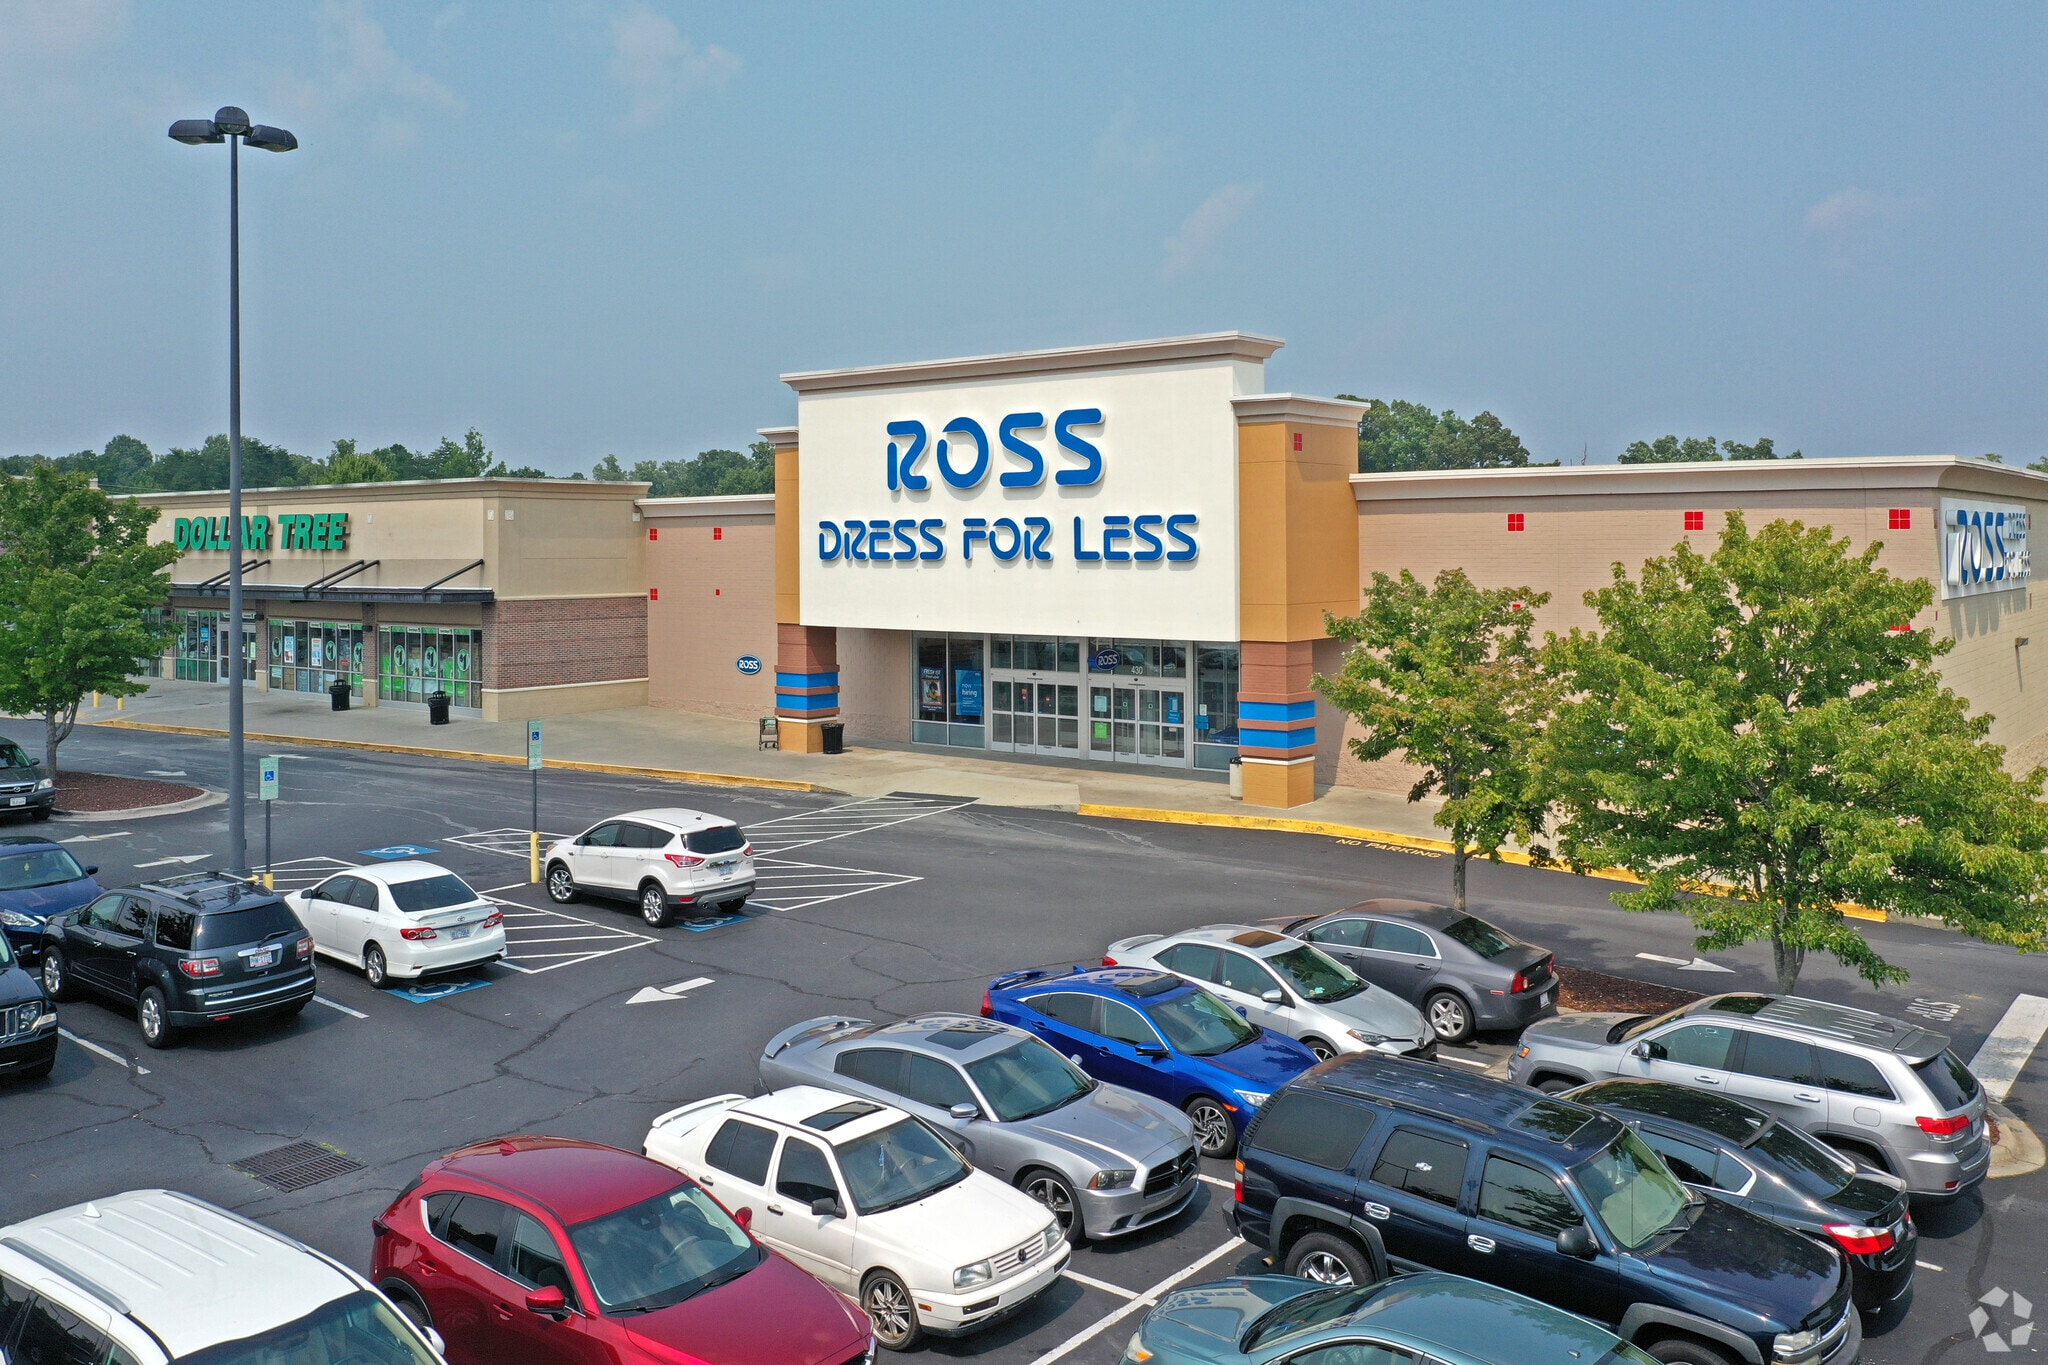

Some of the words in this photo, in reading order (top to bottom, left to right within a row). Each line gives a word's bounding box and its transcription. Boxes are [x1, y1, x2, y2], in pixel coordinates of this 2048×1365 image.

[887, 408, 1103, 491] ROSS
[278, 513, 348, 550] TREE
[819, 519, 944, 561] DRESS
[964, 517, 1052, 561] FOR
[1074, 514, 1199, 561] LESS
[1946, 510, 2004, 585] ROSS
[738, 659, 759, 670] ROSS
[1098, 654, 1118, 666] ROSS
[1131, 666, 1144, 675] 430
[961, 689, 978, 698] hiring
[1336, 838, 1362, 847] NO
[1366, 842, 1442, 858] PARKING
